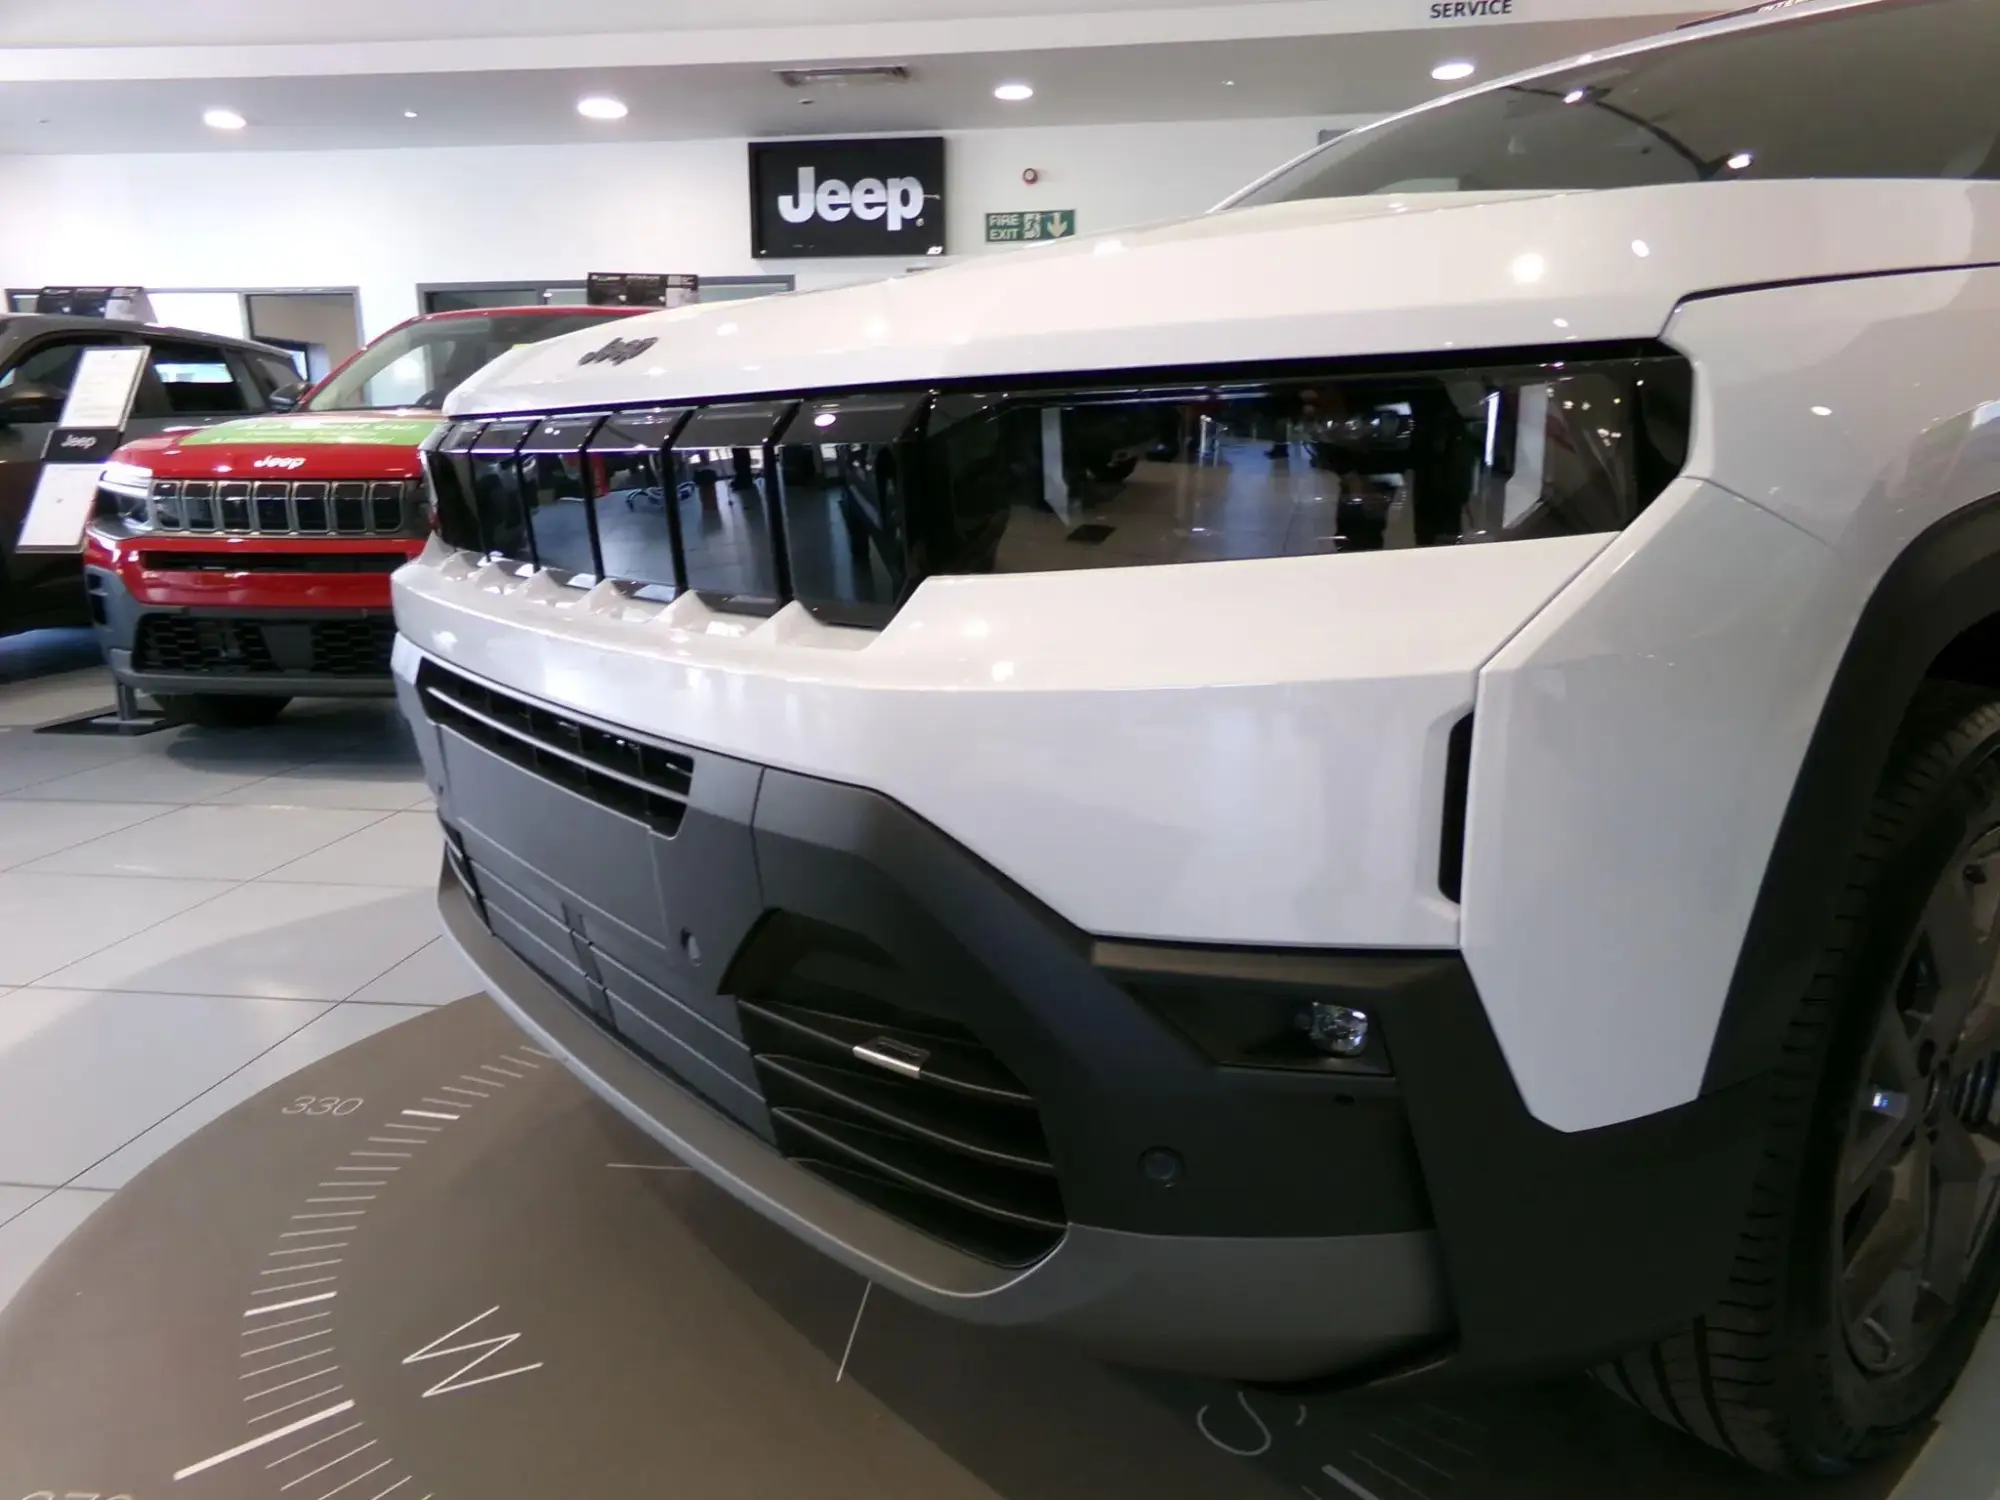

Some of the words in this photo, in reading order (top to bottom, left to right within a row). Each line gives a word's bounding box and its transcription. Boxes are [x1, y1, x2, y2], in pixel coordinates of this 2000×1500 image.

[1430, 0, 1512, 18] SERVICE
[777, 166, 925, 231] Jeep
[988, 214, 1020, 227] FIRE
[989, 228, 1019, 240] EXIT
[60, 434, 97, 450] Jeep
[253, 455, 307, 470] Jeep
[281, 1096, 363, 1116] 330
